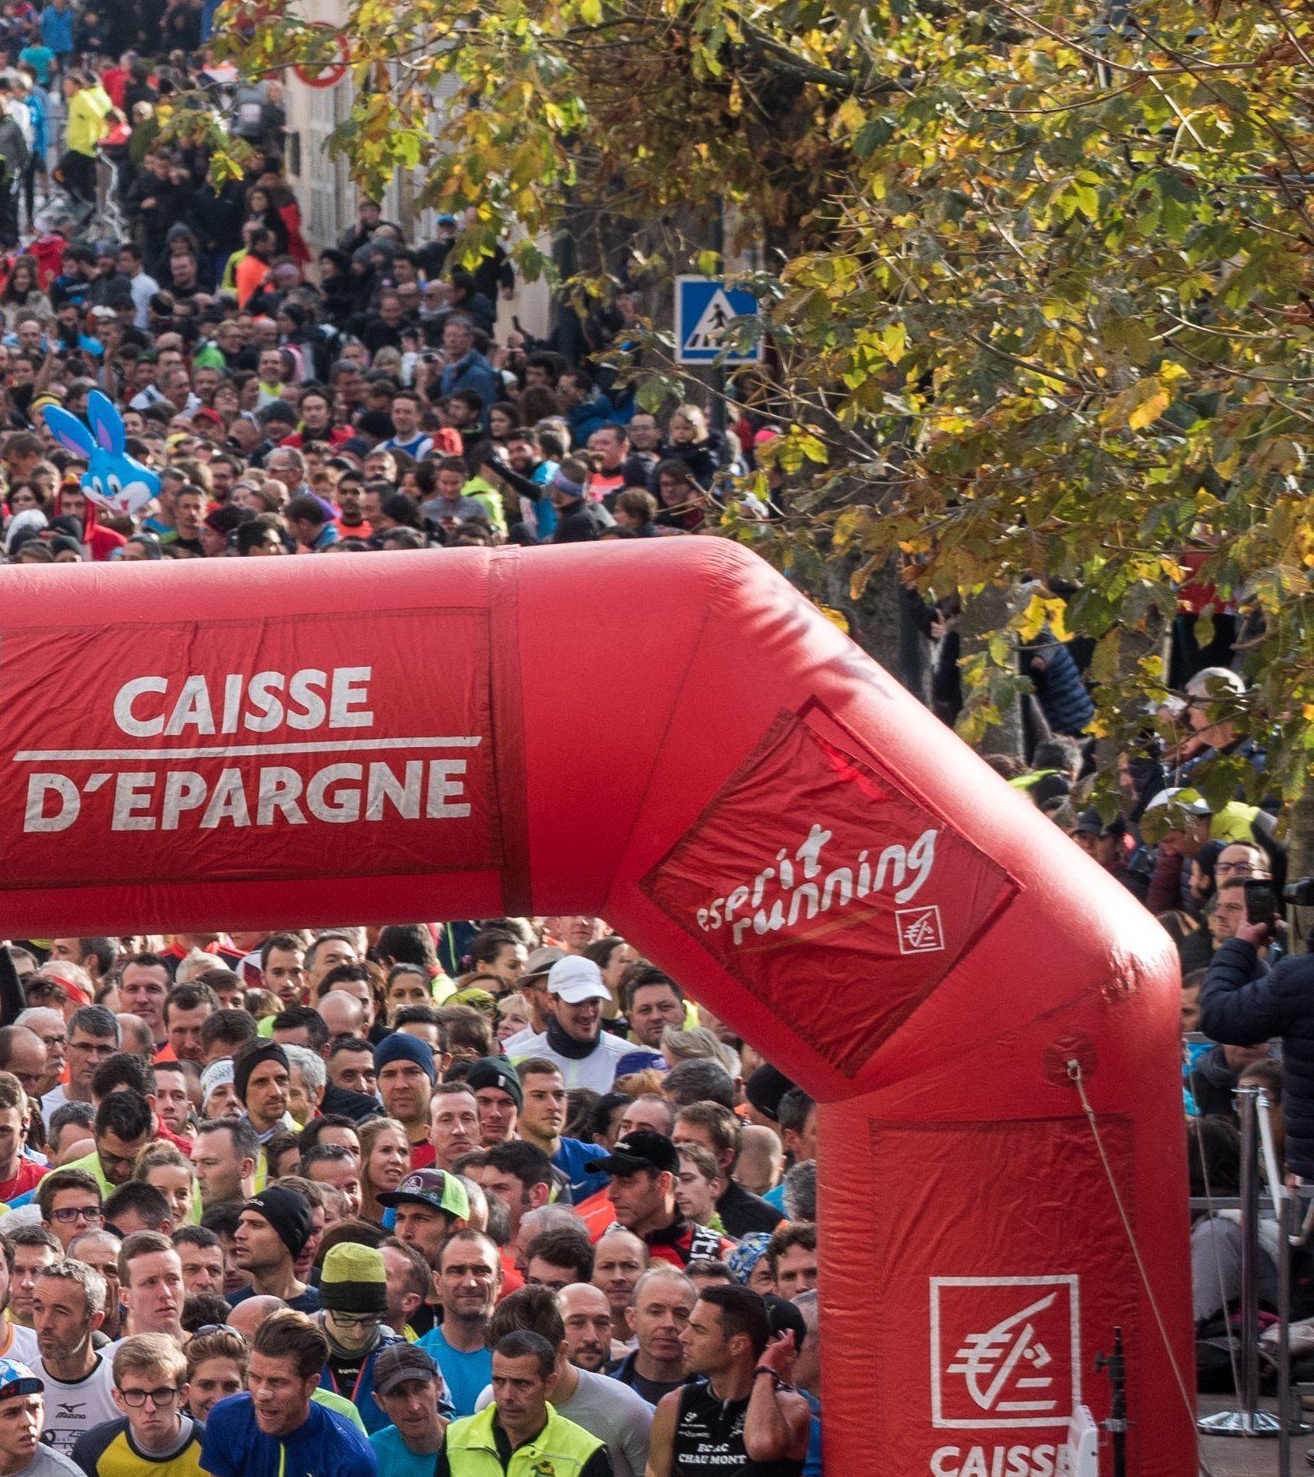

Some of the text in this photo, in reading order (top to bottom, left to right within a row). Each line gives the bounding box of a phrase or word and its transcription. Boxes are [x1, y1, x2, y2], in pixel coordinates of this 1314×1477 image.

[113, 666, 374, 737] CAISSE
[23, 759, 471, 833] D'EPARGNE
[697, 823, 832, 932] esprit
[733, 829, 938, 945] running
